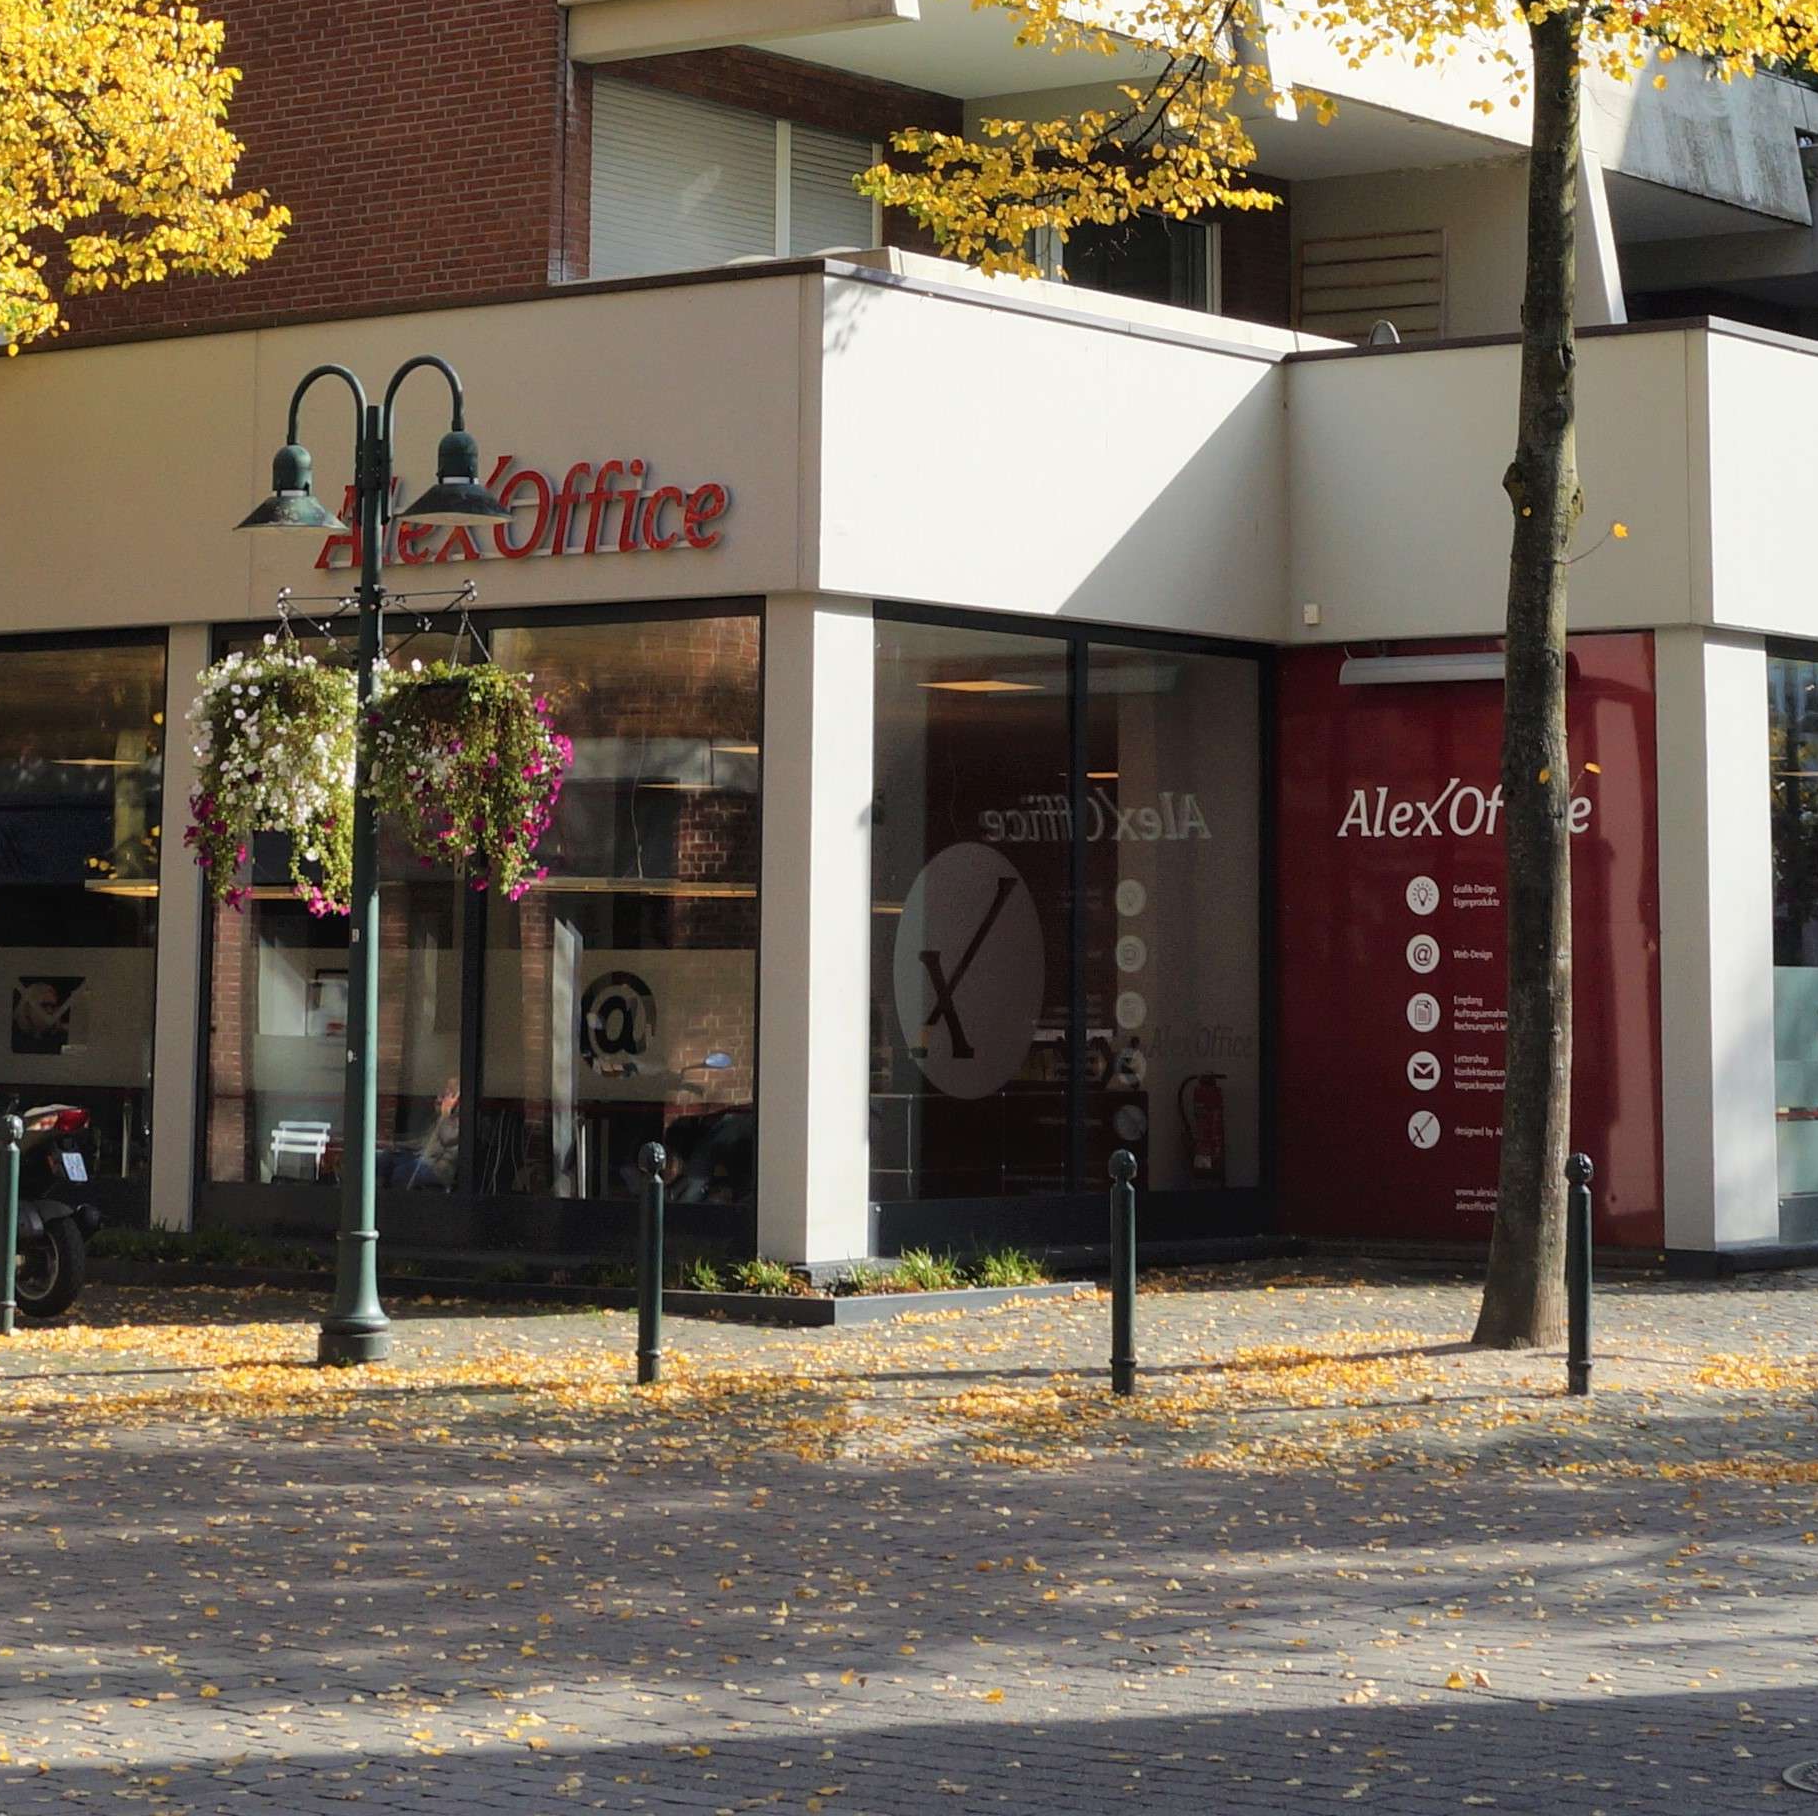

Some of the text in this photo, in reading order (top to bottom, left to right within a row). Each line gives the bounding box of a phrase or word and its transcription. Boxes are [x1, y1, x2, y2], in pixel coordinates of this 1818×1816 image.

[1336, 777, 1593, 837] AlexOfe
[1453, 1009, 1508, 1020] Auftragsannahm
[1453, 1067, 1506, 1077] Konfektionierun
